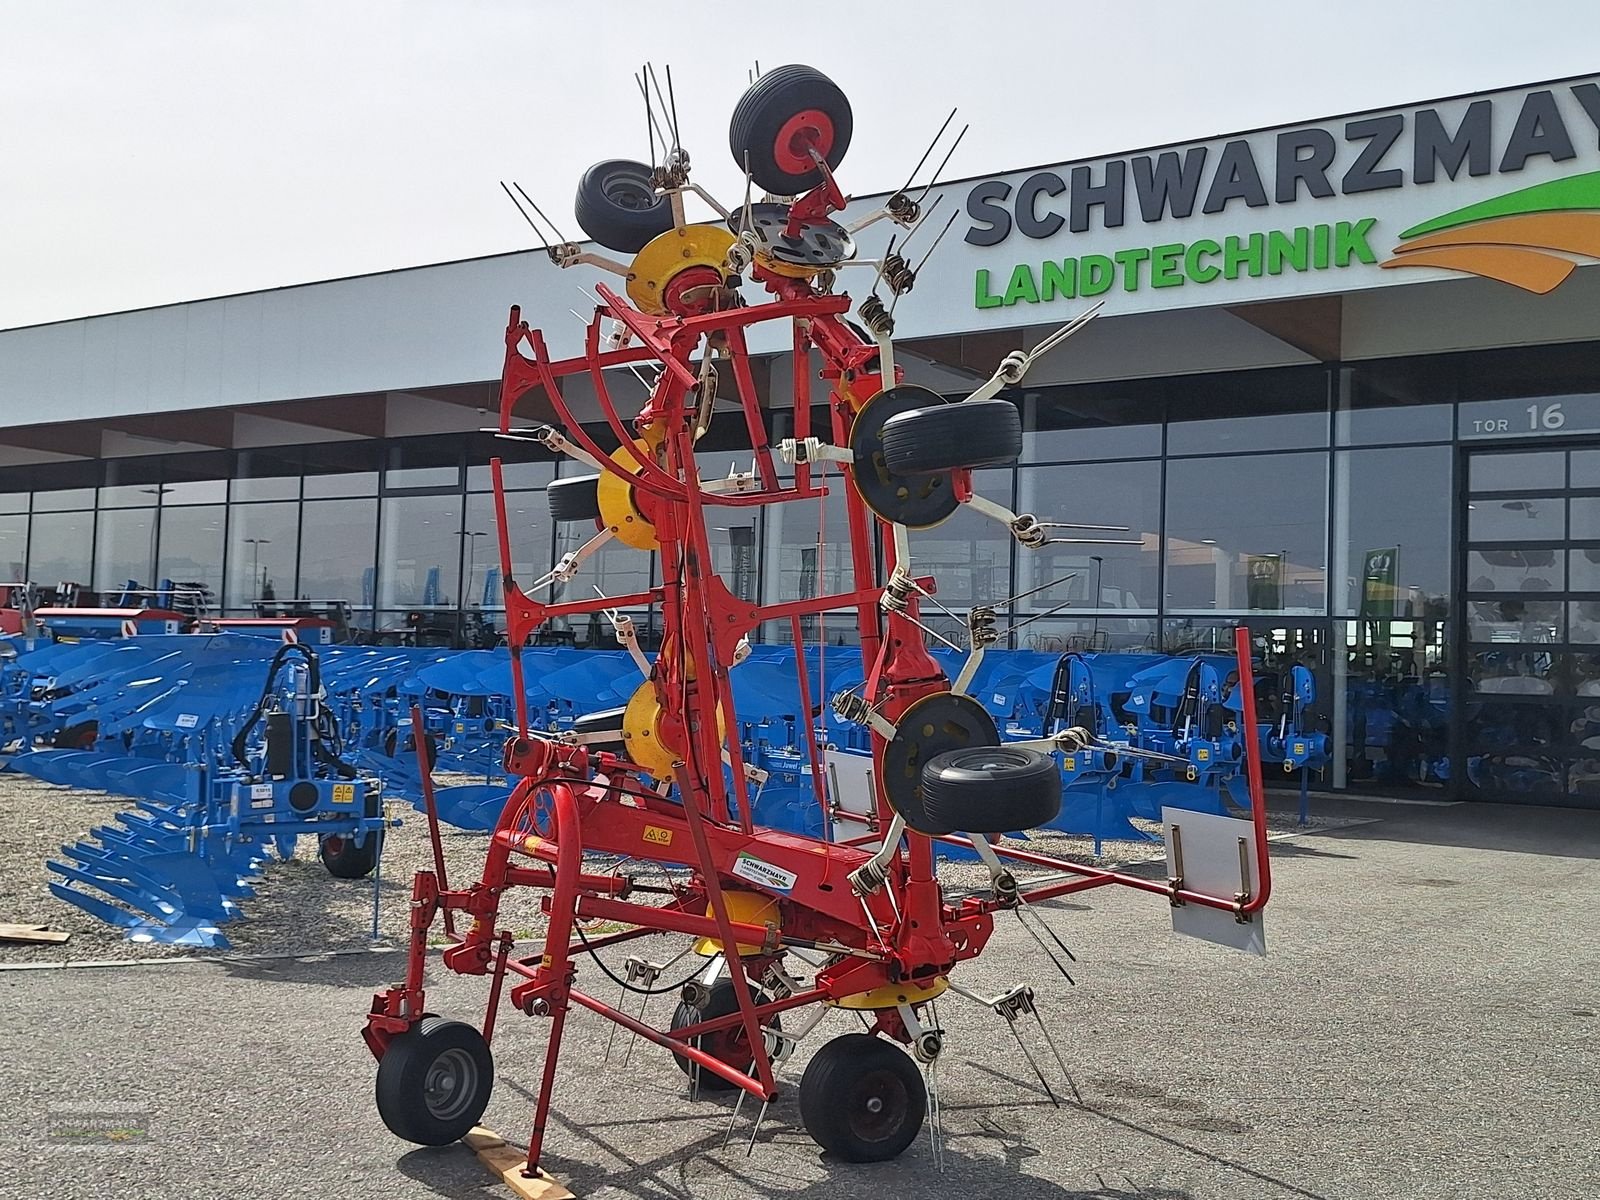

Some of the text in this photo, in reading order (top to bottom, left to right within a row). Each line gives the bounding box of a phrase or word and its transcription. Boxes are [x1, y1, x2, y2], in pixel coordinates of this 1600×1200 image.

[975, 217, 1378, 309] LANDTECHNIK
[1473, 403, 1566, 433] TOR 16
[742, 858, 787, 882] SCHWARZMAYR
